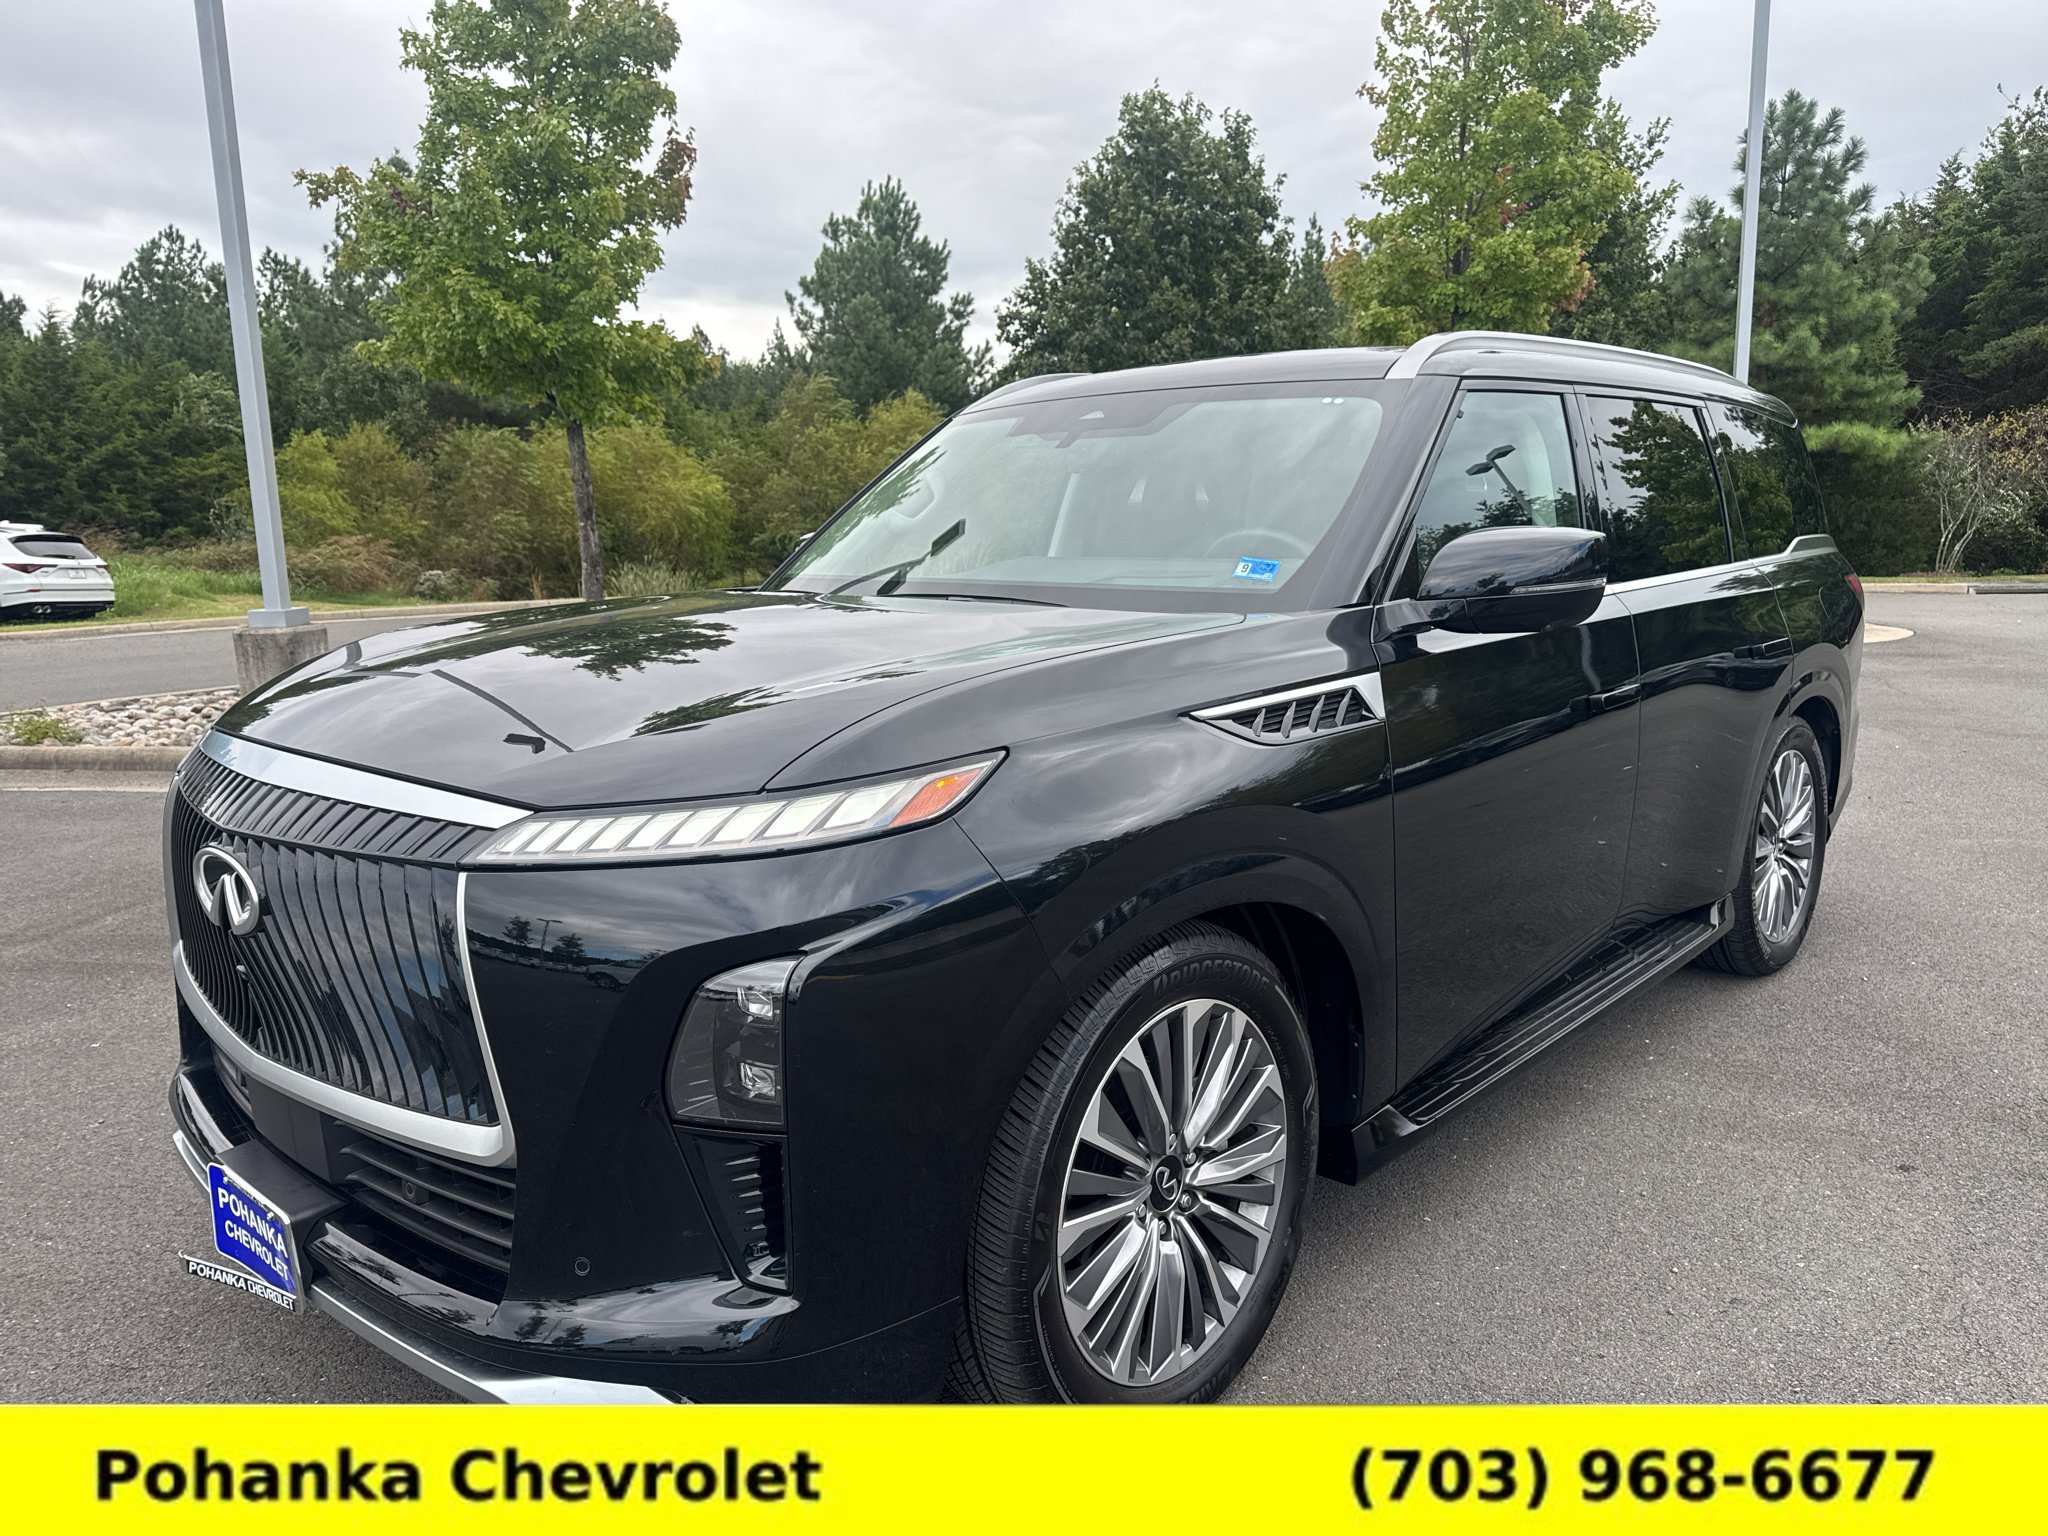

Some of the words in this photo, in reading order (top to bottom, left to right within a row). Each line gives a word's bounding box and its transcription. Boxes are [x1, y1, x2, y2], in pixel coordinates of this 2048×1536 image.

[1241, 563, 1250, 573] 9
[217, 1187, 288, 1258] POHANKA
[224, 1220, 289, 1281] CHEVROLET
[188, 1261, 247, 1290] POHANKA
[247, 1280, 294, 1311] CHEVROLET
